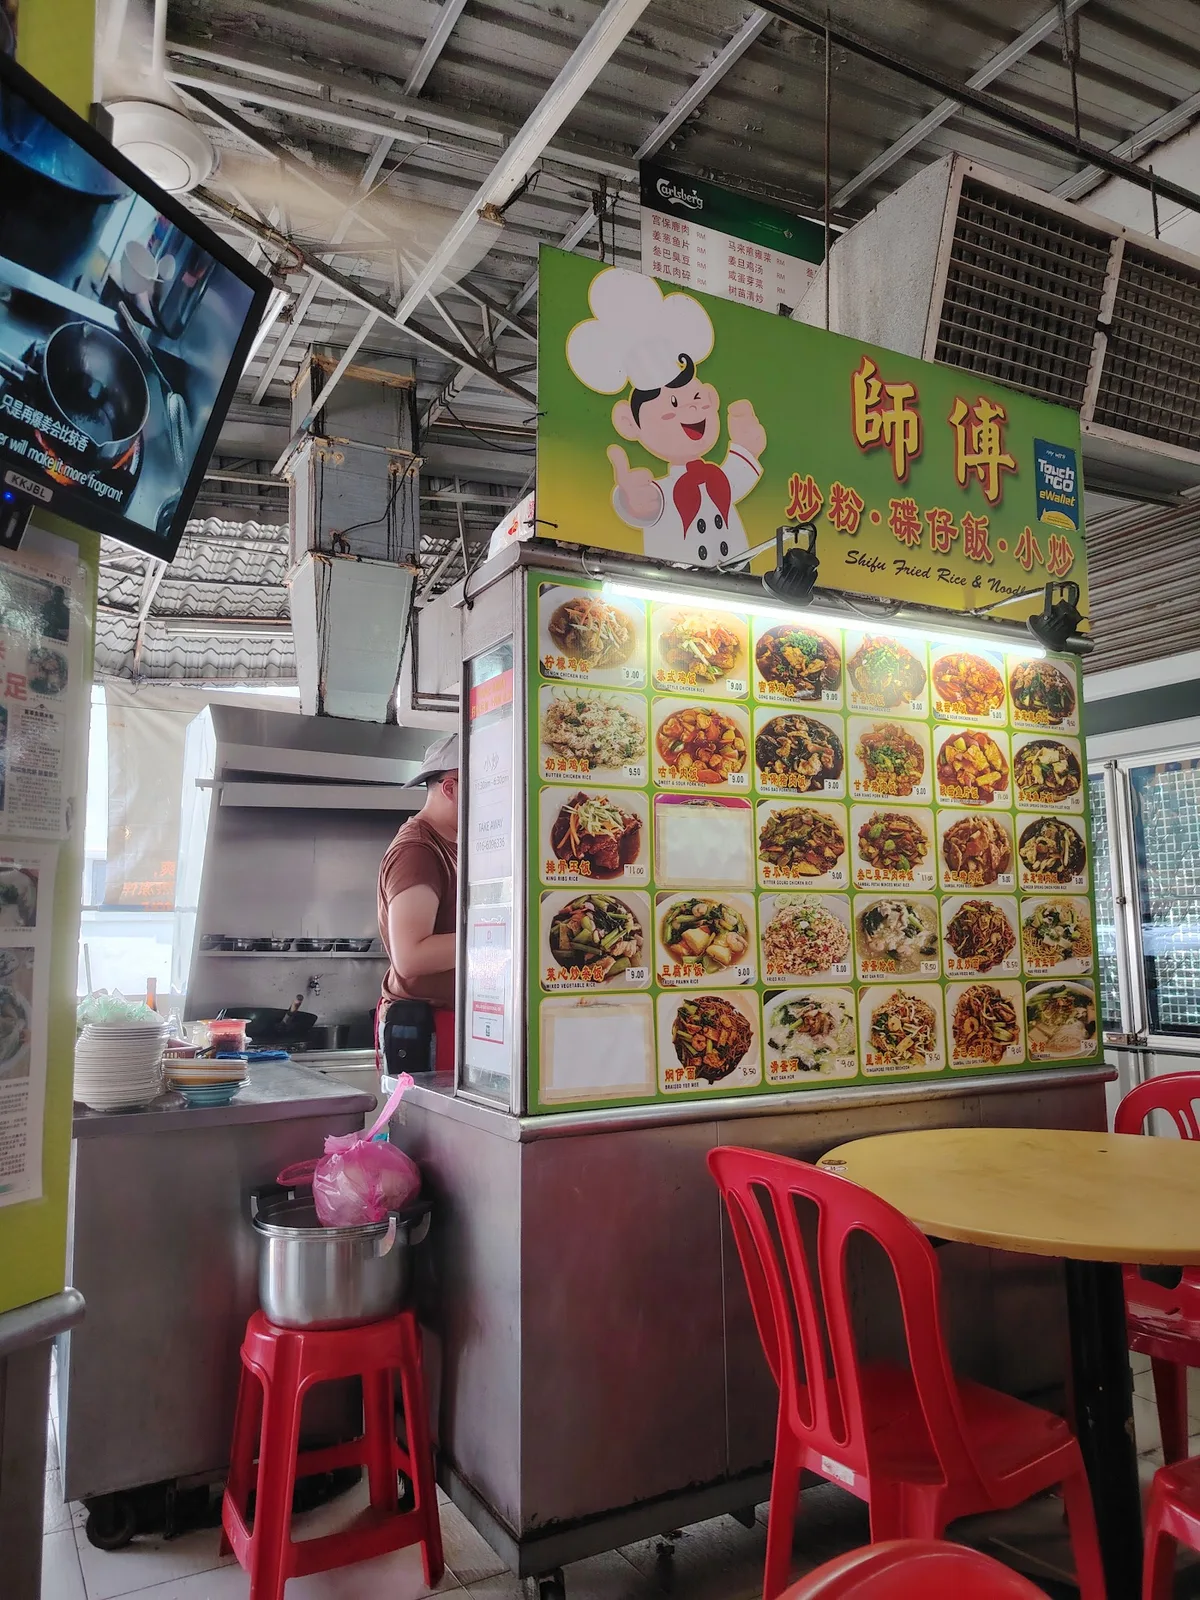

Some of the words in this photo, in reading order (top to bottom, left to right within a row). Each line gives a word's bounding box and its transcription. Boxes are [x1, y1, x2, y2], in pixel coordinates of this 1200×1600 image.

[656, 178, 703, 210] Carlsberg
[852, 355, 1017, 506] 師傅
[9, 438, 29, 456] will
[27, 448, 54, 469] make
[54, 457, 64, 473] it
[62, 465, 86, 484] more
[87, 474, 123, 503] fragrant
[1038, 458, 1075, 480] Touch
[11, 474, 46, 499] KKJBL
[1039, 490, 1076, 507] eWallet
[845, 550, 887, 573] Shifu
[893, 559, 932, 580] Fried
[937, 568, 967, 586] Rice
[971, 575, 982, 588] &
[987, 578, 1026, 595] Noodl
[544, 654, 589, 673] 柠檬鸡饭
[625, 670, 640, 679] 9.00
[657, 669, 698, 686] 泰式鸡饭
[731, 681, 743, 690] 9.00
[826, 692, 838, 700] 9.00
[545, 757, 590, 773] 奶油鸡饭
[628, 767, 641, 776] 9.50
[731, 775, 744, 783] 9.00
[828, 781, 839, 789] 9.00
[916, 787, 926, 795] 9.00
[545, 859, 591, 875] 排骨王饭
[763, 866, 800, 879] 苦瓜鸡饭
[831, 871, 843, 880] 9.00
[662, 964, 705, 977] 豆腐虾饭
[766, 962, 785, 974] 炒饭
[836, 964, 847, 973] 8.00
[948, 958, 979, 970] 印度炒面
[546, 965, 604, 982] 菜心炒杂饭
[630, 969, 645, 979] 9.00
[737, 967, 751, 977] 9.00
[770, 1058, 798, 1073] 滑蛋河
[865, 1052, 891, 1066] 星洲米
[664, 1066, 696, 1082] 焖伊面
[742, 1067, 757, 1076] 8.50
